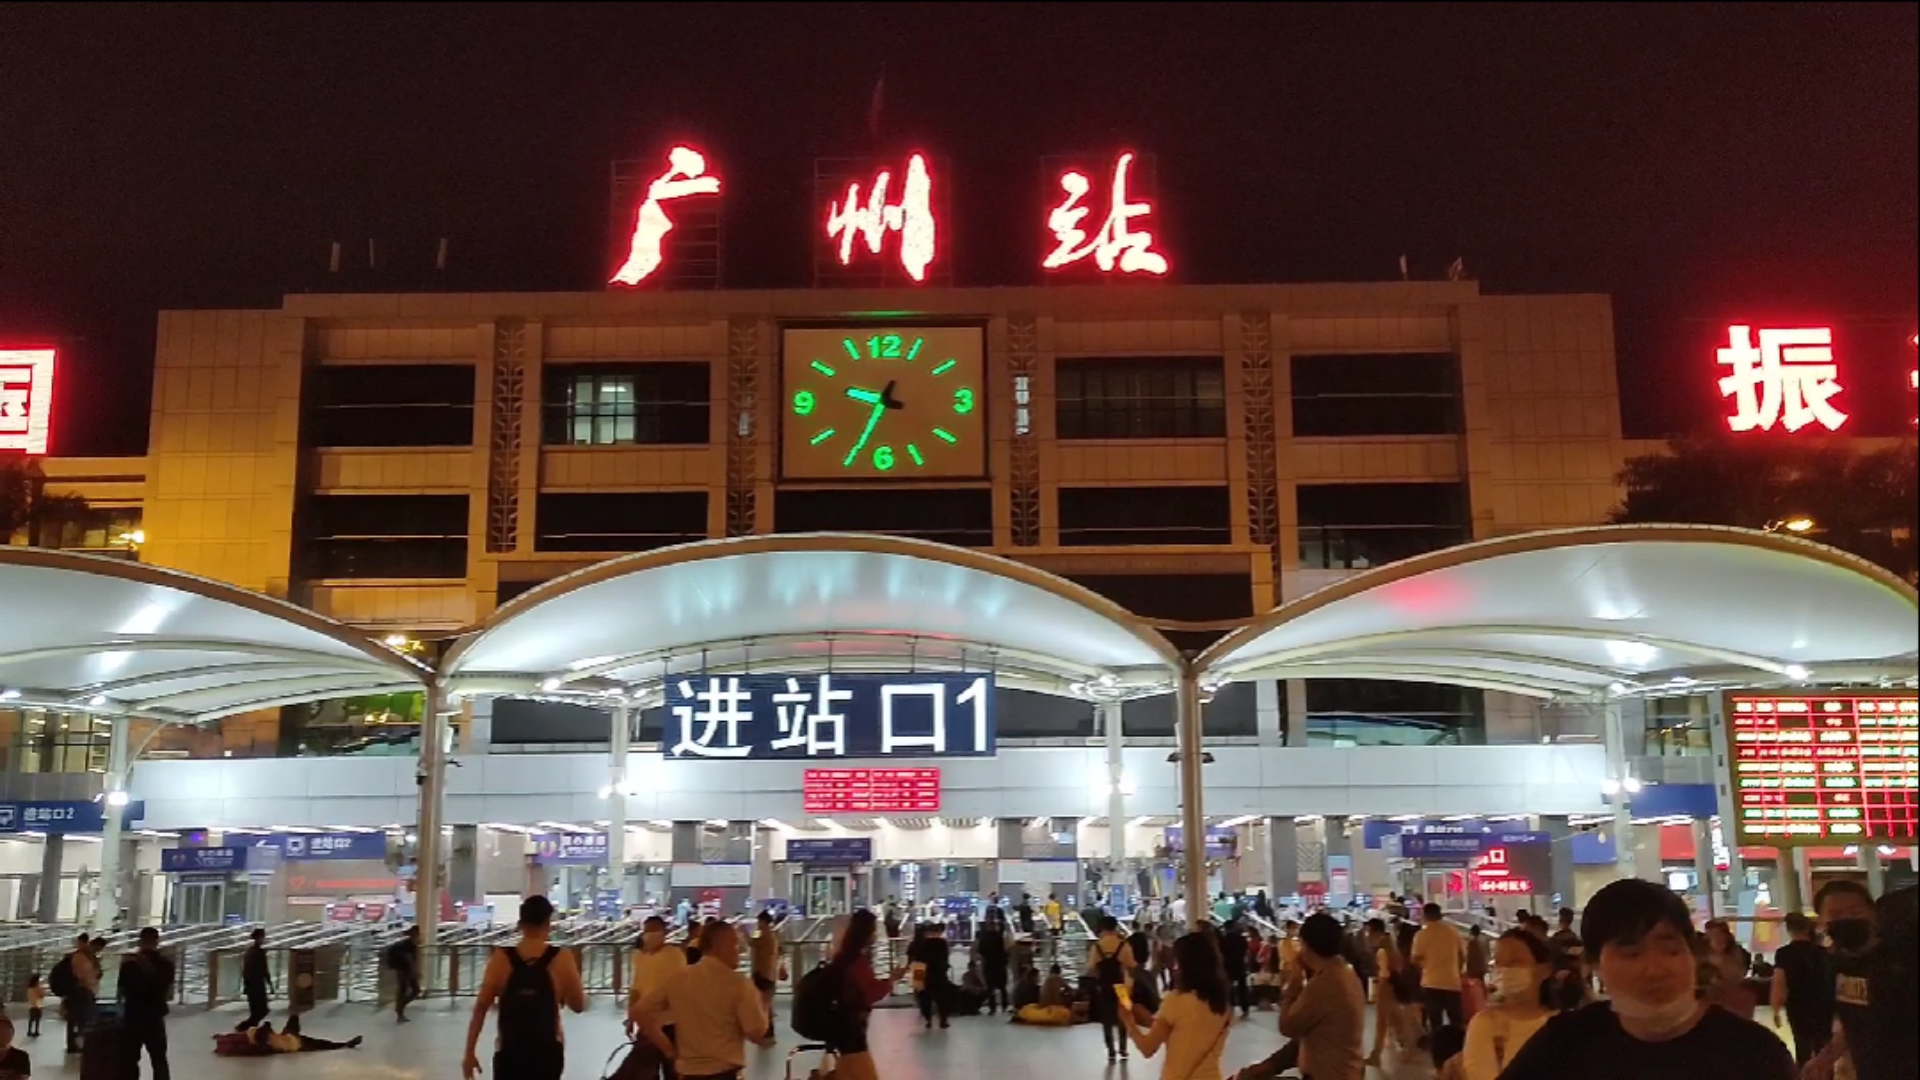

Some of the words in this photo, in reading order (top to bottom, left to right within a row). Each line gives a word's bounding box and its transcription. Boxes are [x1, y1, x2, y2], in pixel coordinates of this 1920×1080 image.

[609, 146, 1168, 285] 广州站
[866, 334, 902, 359] 12
[1716, 325, 1918, 432] 振
[793, 390, 815, 415] 9
[953, 388, 973, 414] 3
[872, 445, 895, 470] 6
[671, 675, 988, 758] 进站口1
